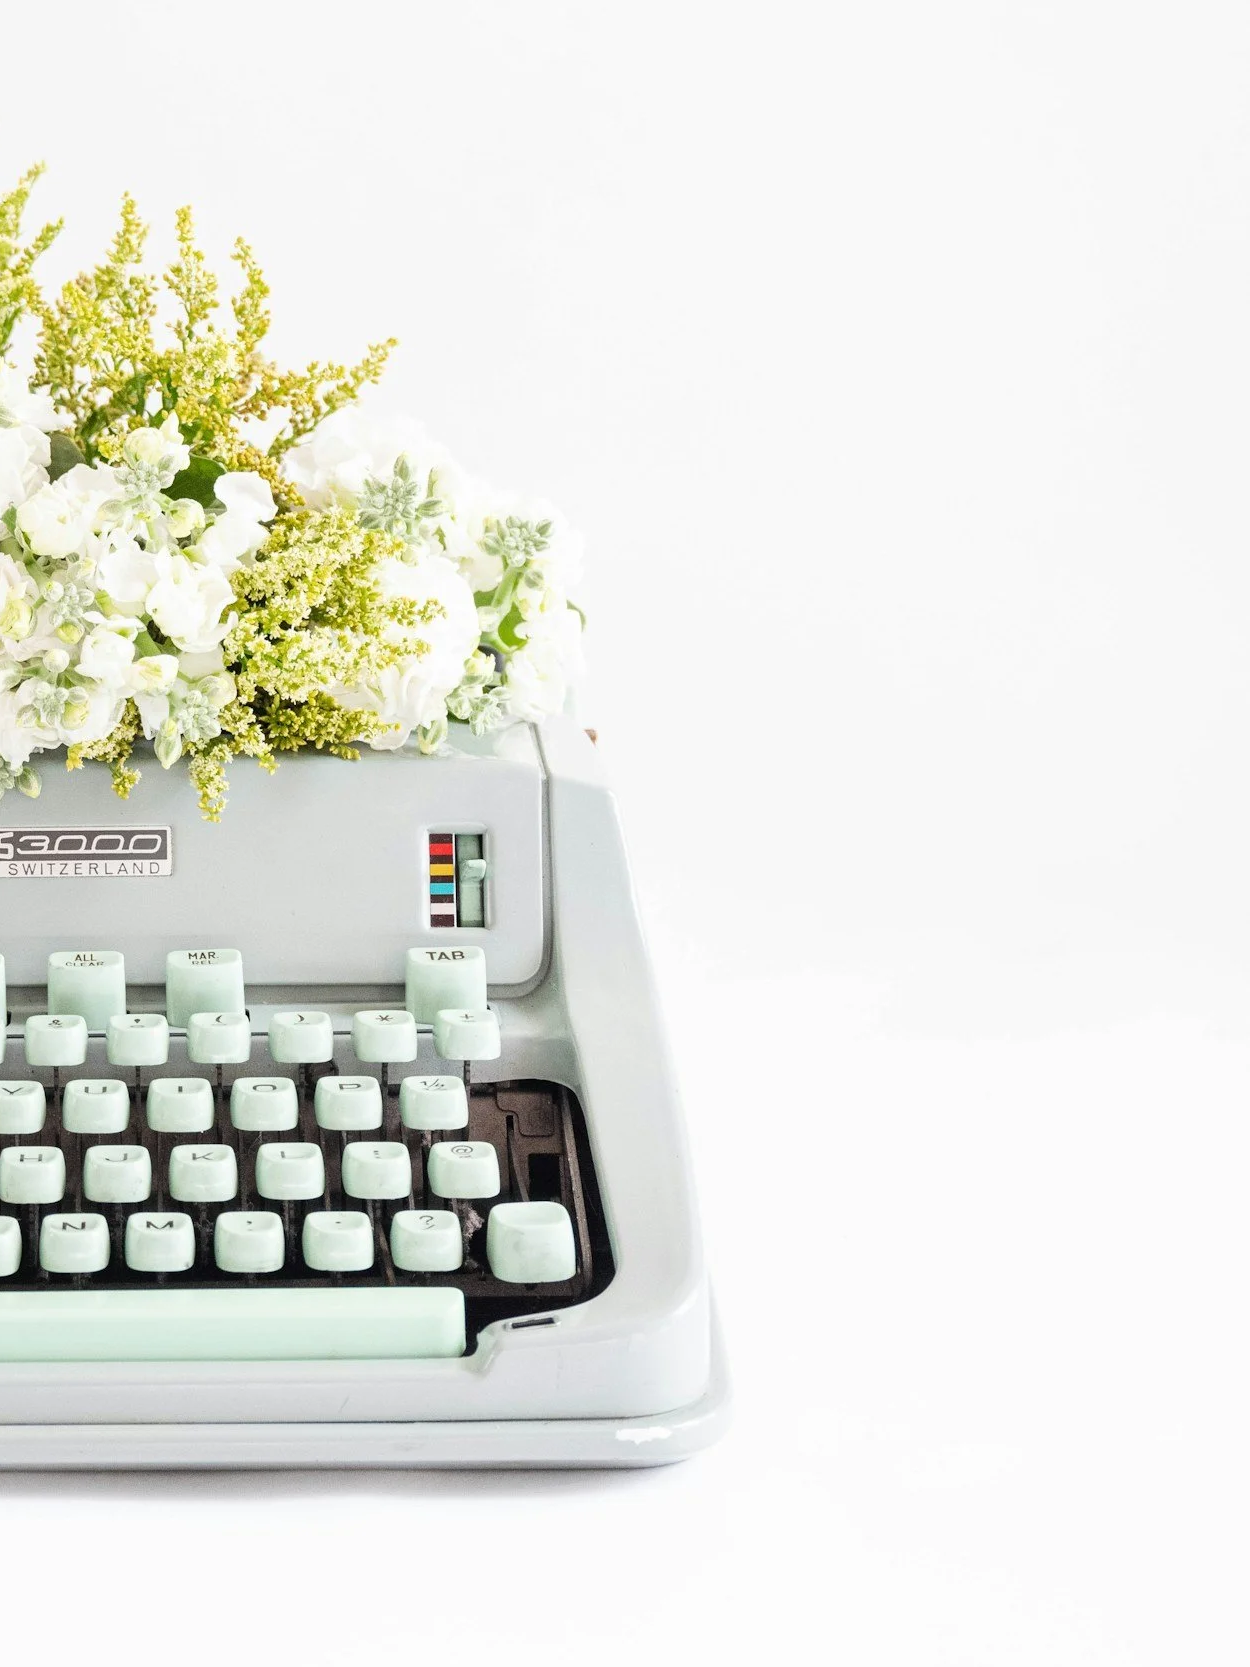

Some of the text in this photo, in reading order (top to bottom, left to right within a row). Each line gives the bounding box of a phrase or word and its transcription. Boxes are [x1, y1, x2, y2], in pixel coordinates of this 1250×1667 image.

[16, 834, 162, 855] 3000
[8, 861, 161, 876] SWITZERLAND
[74, 953, 98, 962] ALL
[425, 950, 465, 961] TAB
[1, 1087, 23, 1096] Y
[252, 1084, 278, 1092] O
[338, 1083, 362, 1091] P
[450, 1144, 474, 1155] @
[19, 1153, 43, 1163] H
[104, 1152, 128, 1163] J
[191, 1152, 213, 1161] K
[280, 1150, 304, 1160] L
[61, 1221, 87, 1231] N
[145, 1220, 174, 1230] M
